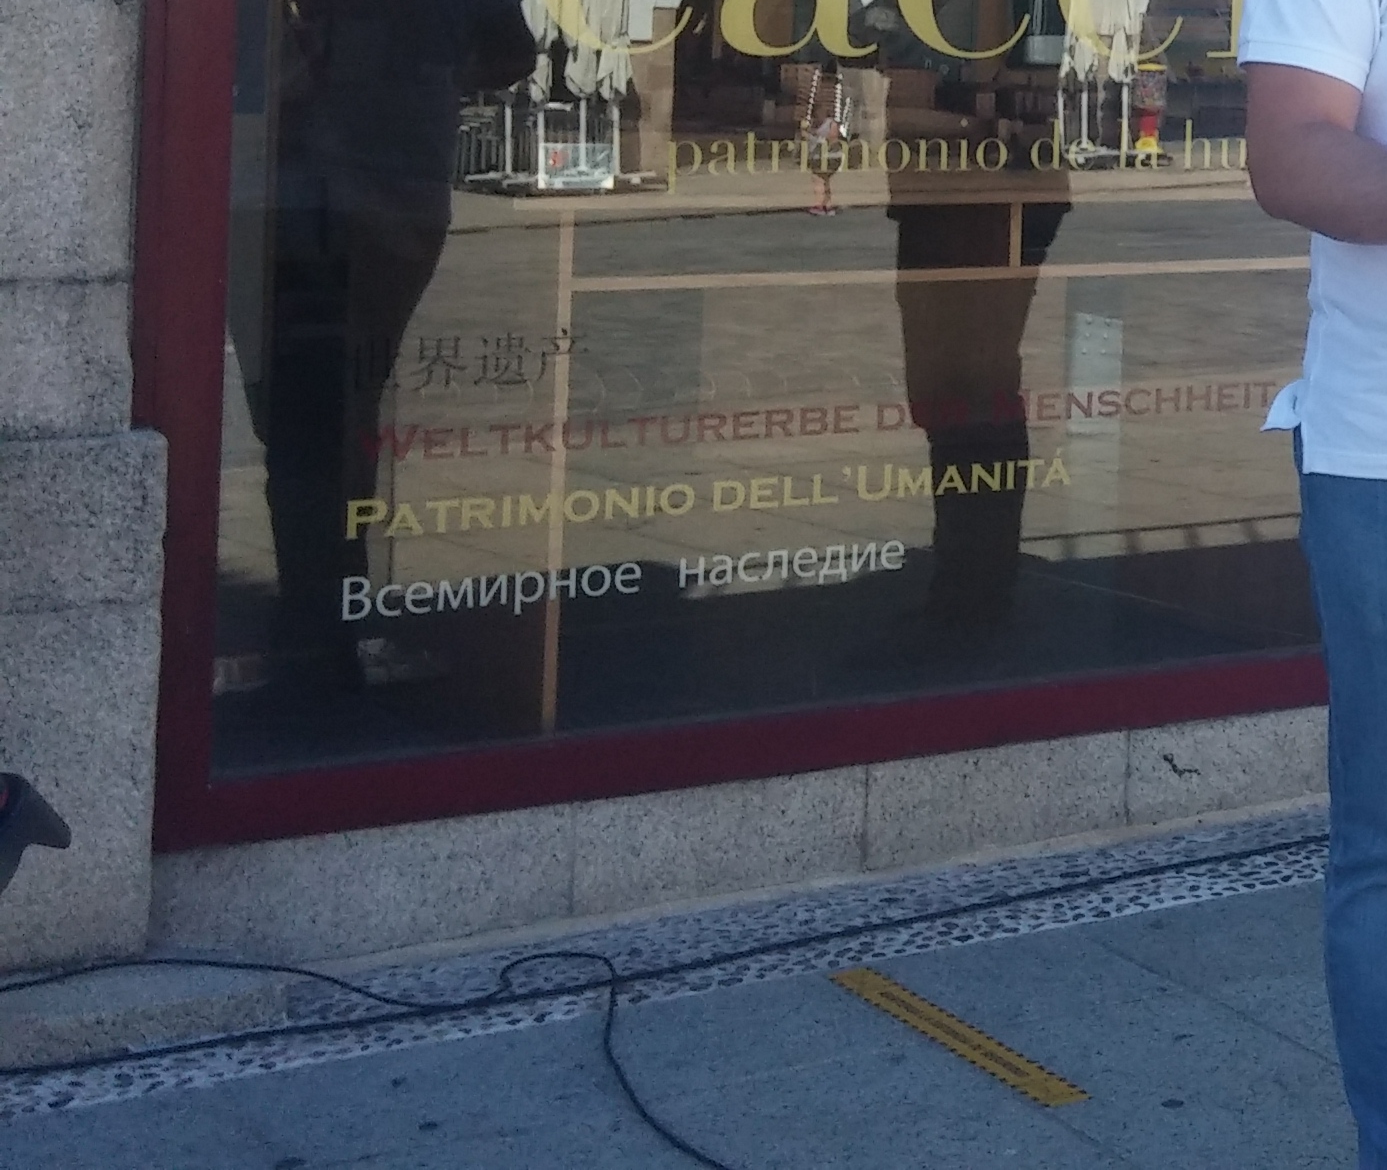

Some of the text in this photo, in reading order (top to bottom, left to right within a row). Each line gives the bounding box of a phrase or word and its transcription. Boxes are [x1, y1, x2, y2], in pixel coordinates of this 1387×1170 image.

[667, 128, 1009, 195] patrimonio
[1028, 117, 1092, 172] de
[358, 404, 860, 463] WELTKULTURERBE
[994, 381, 1277, 428] MENSCHHEIT
[345, 483, 695, 541] PATRIMONIO
[341, 538, 905, 622] Всемирное наследие
